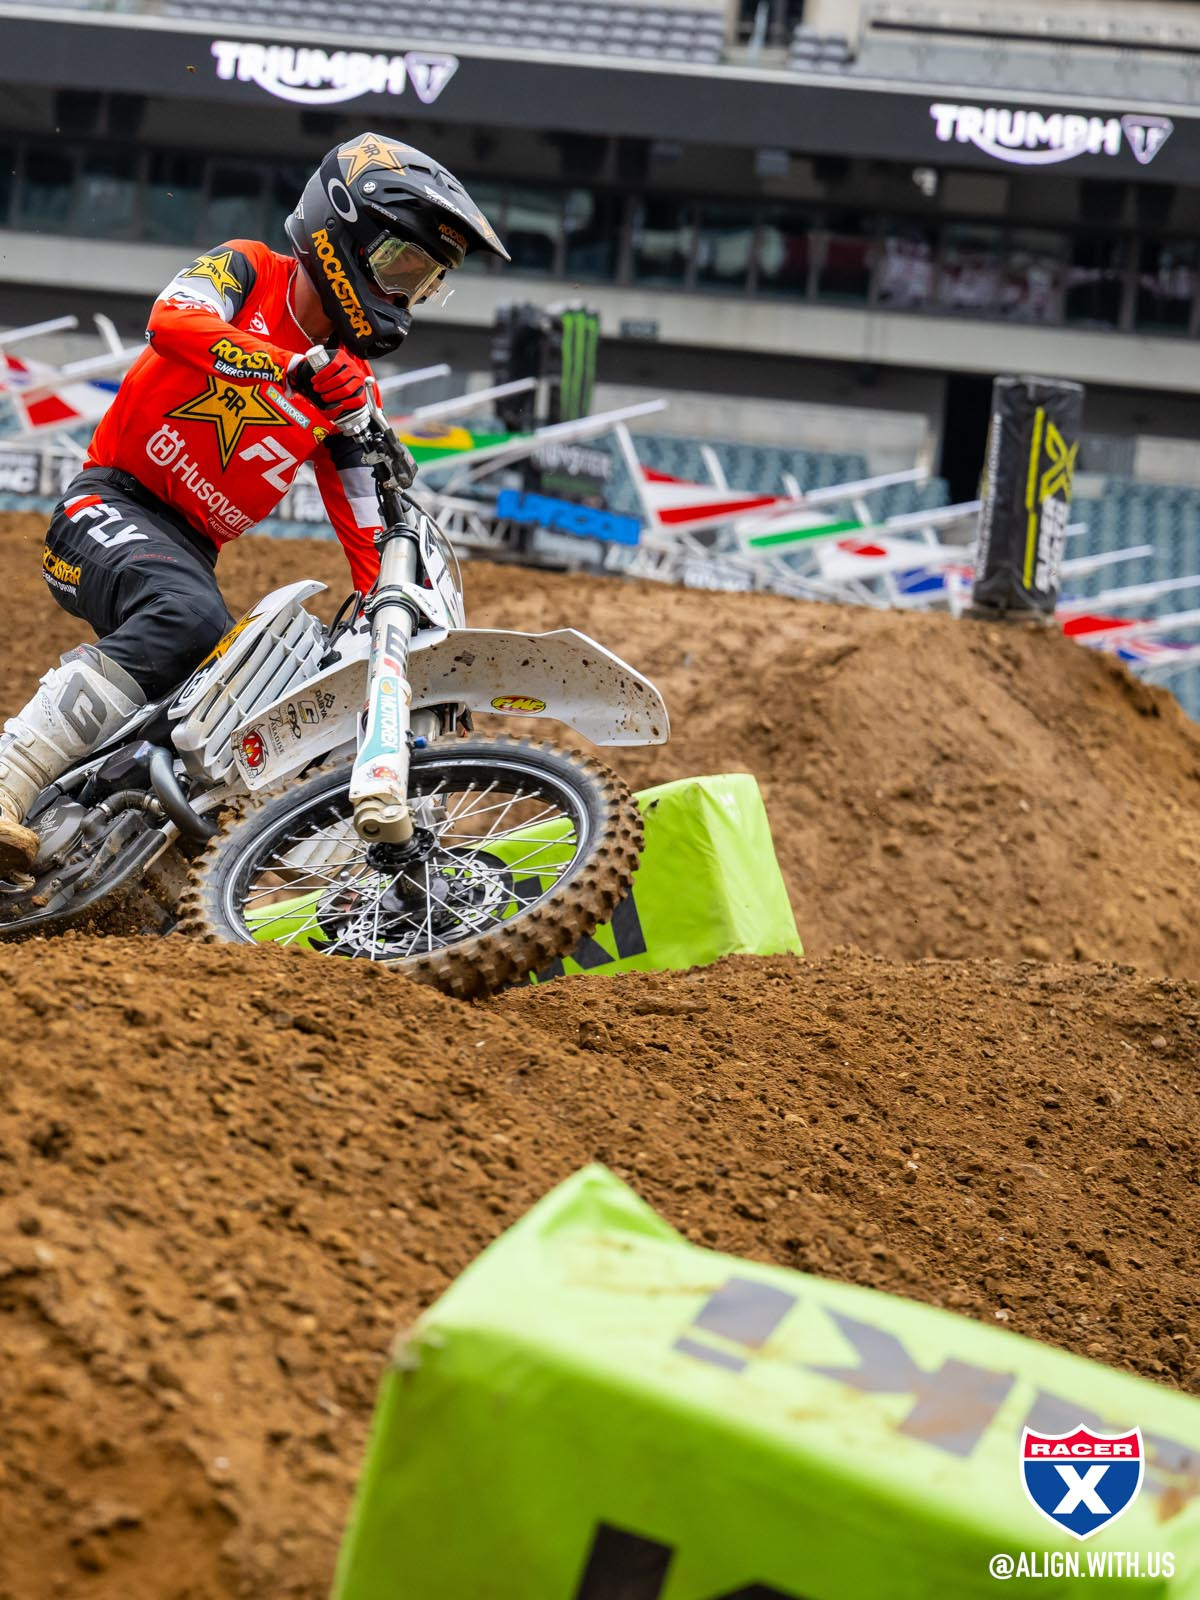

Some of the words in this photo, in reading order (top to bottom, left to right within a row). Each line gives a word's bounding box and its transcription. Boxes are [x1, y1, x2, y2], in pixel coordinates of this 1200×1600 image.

[211, 40, 406, 103] TRIUMPH
[930, 103, 1122, 164] TRIUMPH
[310, 228, 373, 339] ROCKSTAR
[214, 360, 253, 378] ENERGY
[253, 371, 282, 382] DRI
[274, 395, 310, 428] MOTOREX
[64, 494, 149, 548] FLY
[380, 692, 398, 749] MOTOREX
